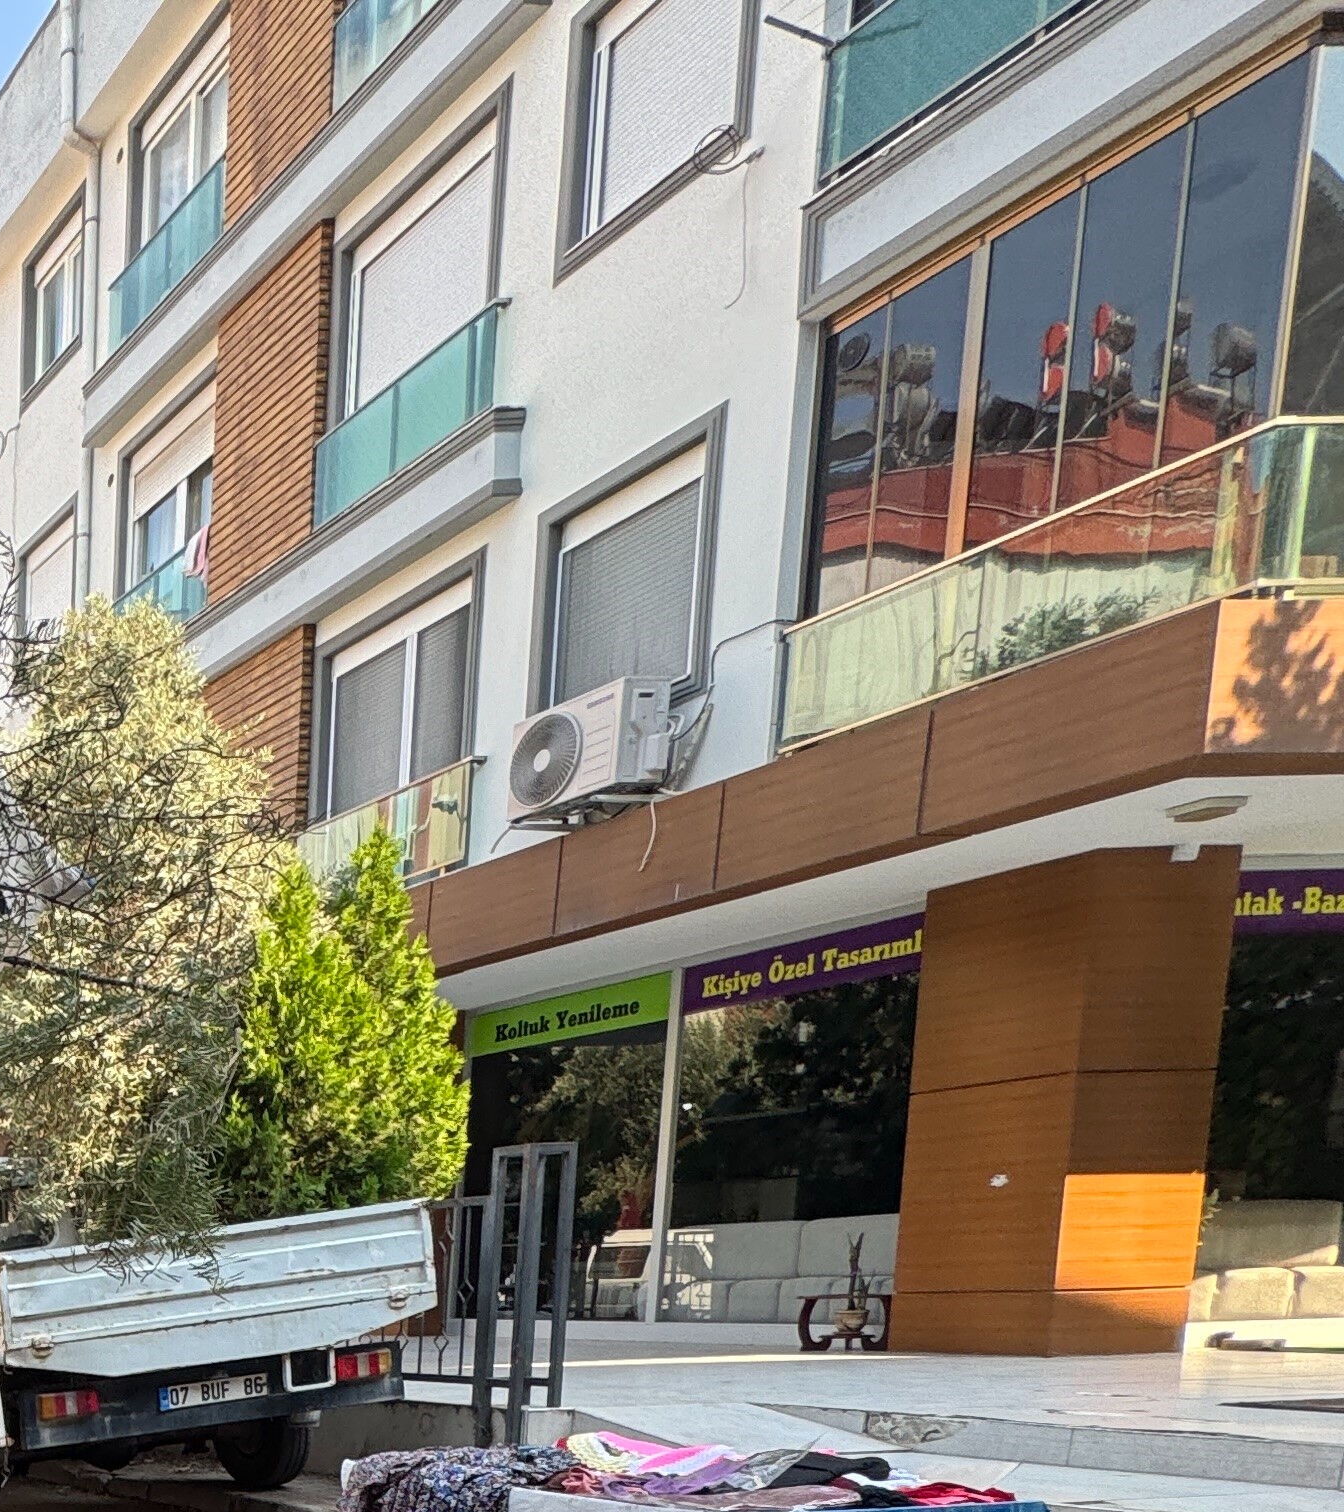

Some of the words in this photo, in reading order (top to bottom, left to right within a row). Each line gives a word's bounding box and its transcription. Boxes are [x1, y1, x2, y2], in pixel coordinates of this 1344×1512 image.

[702, 971, 762, 999] Kişiye
[769, 954, 815, 983] Özel
[495, 1016, 550, 1042] Koltuk
[556, 1001, 640, 1029] Yenileme
[170, 1387, 189, 1405] 07
[201, 1381, 230, 1401] BUF
[244, 1376, 264, 1395] 86
